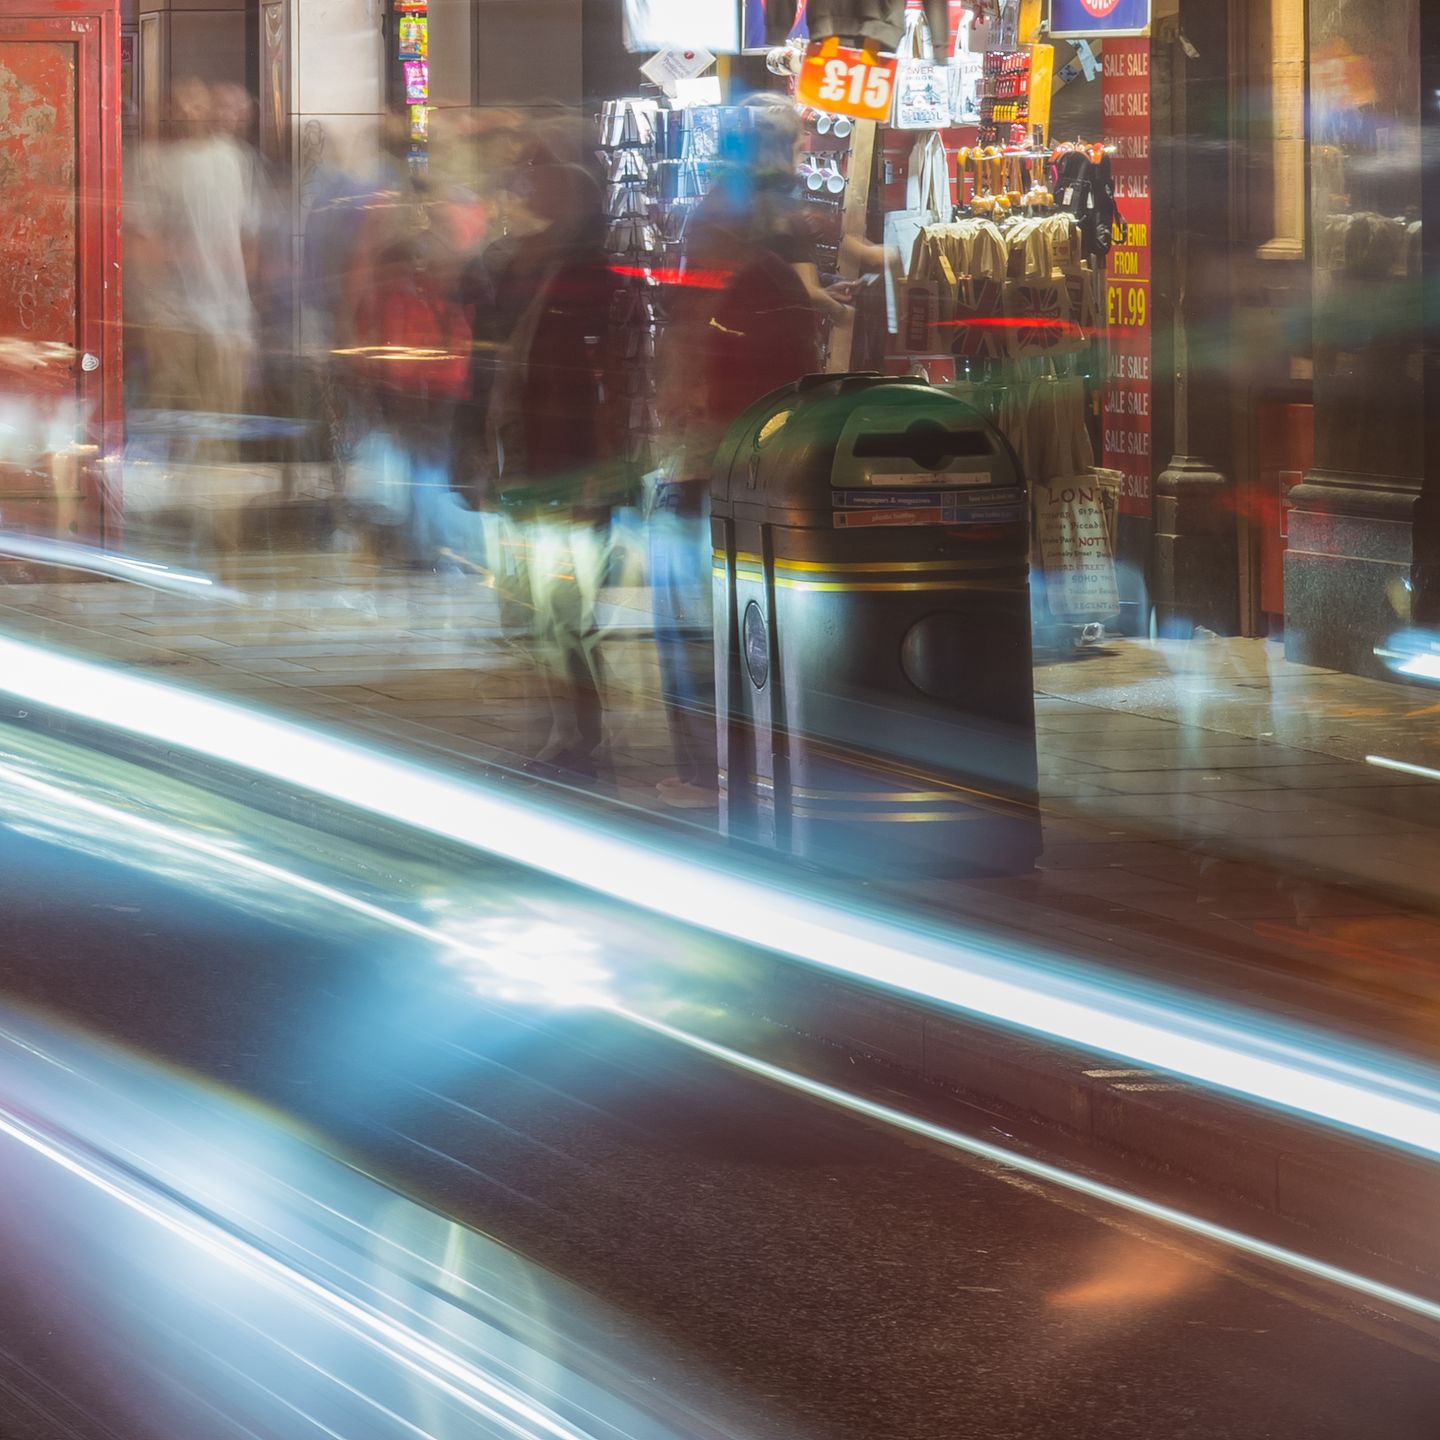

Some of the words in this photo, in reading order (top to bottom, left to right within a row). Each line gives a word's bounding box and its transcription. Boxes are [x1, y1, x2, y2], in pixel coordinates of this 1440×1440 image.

[1104, 54, 1125, 77] SALE
[1127, 52, 1148, 76] SALE
[818, 58, 892, 109] £15
[1104, 93, 1125, 116] SALE
[1127, 92, 1148, 116] SALE
[1127, 135, 1148, 159] SALE
[1127, 175, 1148, 198] SALE
[1114, 251, 1138, 275] FROM
[1107, 286, 1146, 327] £1.99
[1127, 355, 1149, 380] SALE
[1127, 392, 1149, 416] SALE
[1105, 429, 1125, 453] SALE
[1127, 431, 1149, 456] SALE
[1127, 474, 1149, 498] SALE
